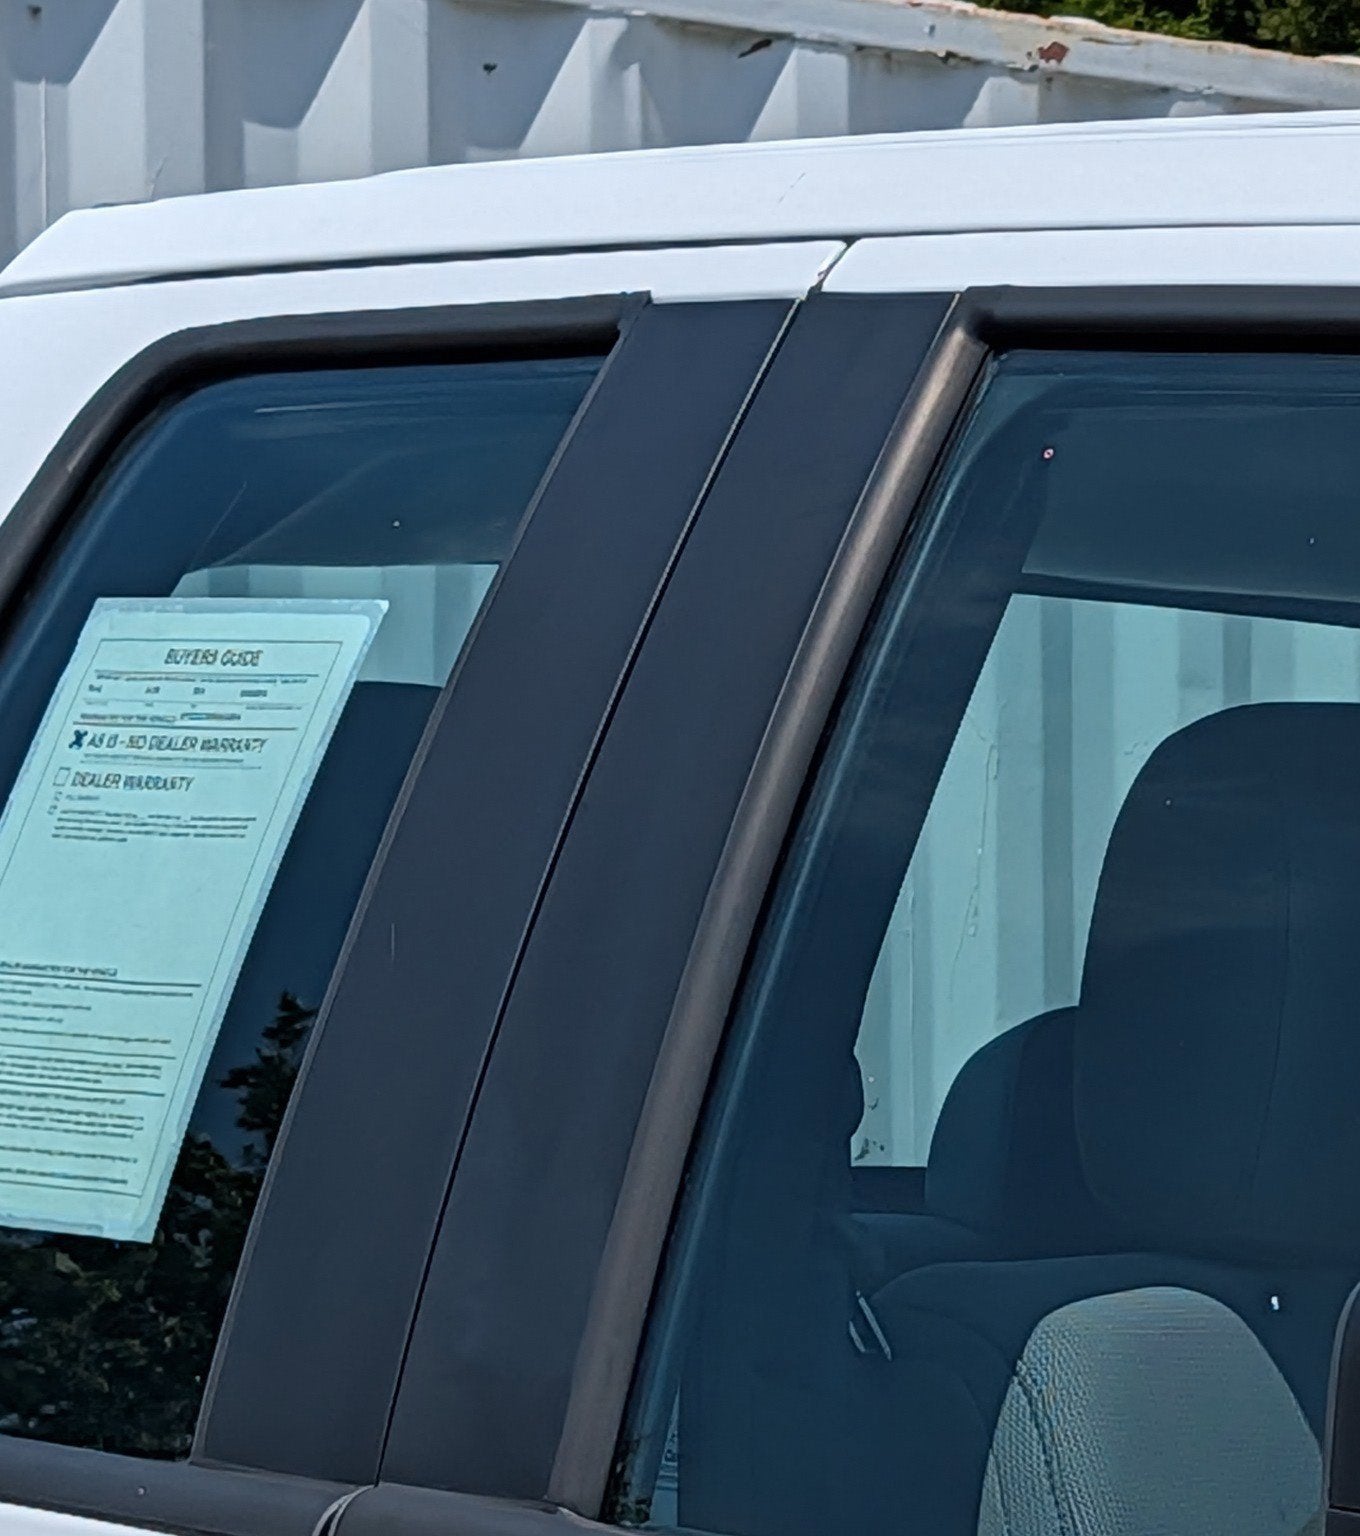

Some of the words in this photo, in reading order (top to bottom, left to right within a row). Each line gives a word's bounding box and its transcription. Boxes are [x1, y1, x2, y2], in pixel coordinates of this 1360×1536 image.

[164, 648, 218, 666] BUYERS
[221, 649, 263, 667] GUIDE
[148, 735, 198, 752] DEALER
[200, 737, 270, 754] WARRANTY
[71, 772, 121, 788] DEALER
[123, 773, 195, 792] WARRANTY
